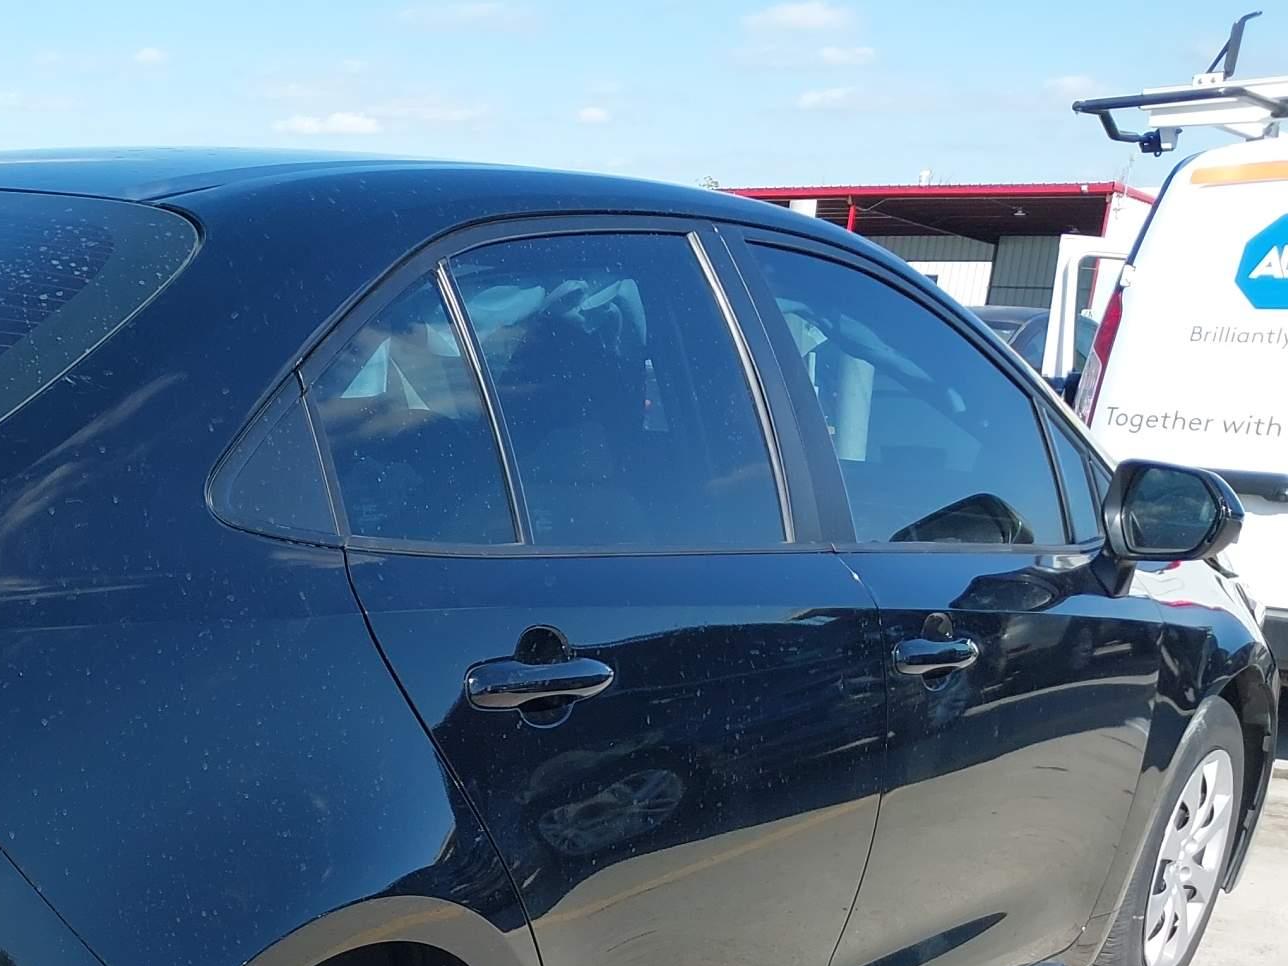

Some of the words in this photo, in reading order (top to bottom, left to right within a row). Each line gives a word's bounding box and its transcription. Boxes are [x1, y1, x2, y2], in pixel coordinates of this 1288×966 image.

[1248, 243, 1288, 279] A
[1189, 325, 1288, 350] Brilliantly
[1107, 405, 1214, 434] Together
[1223, 415, 1282, 437] with
